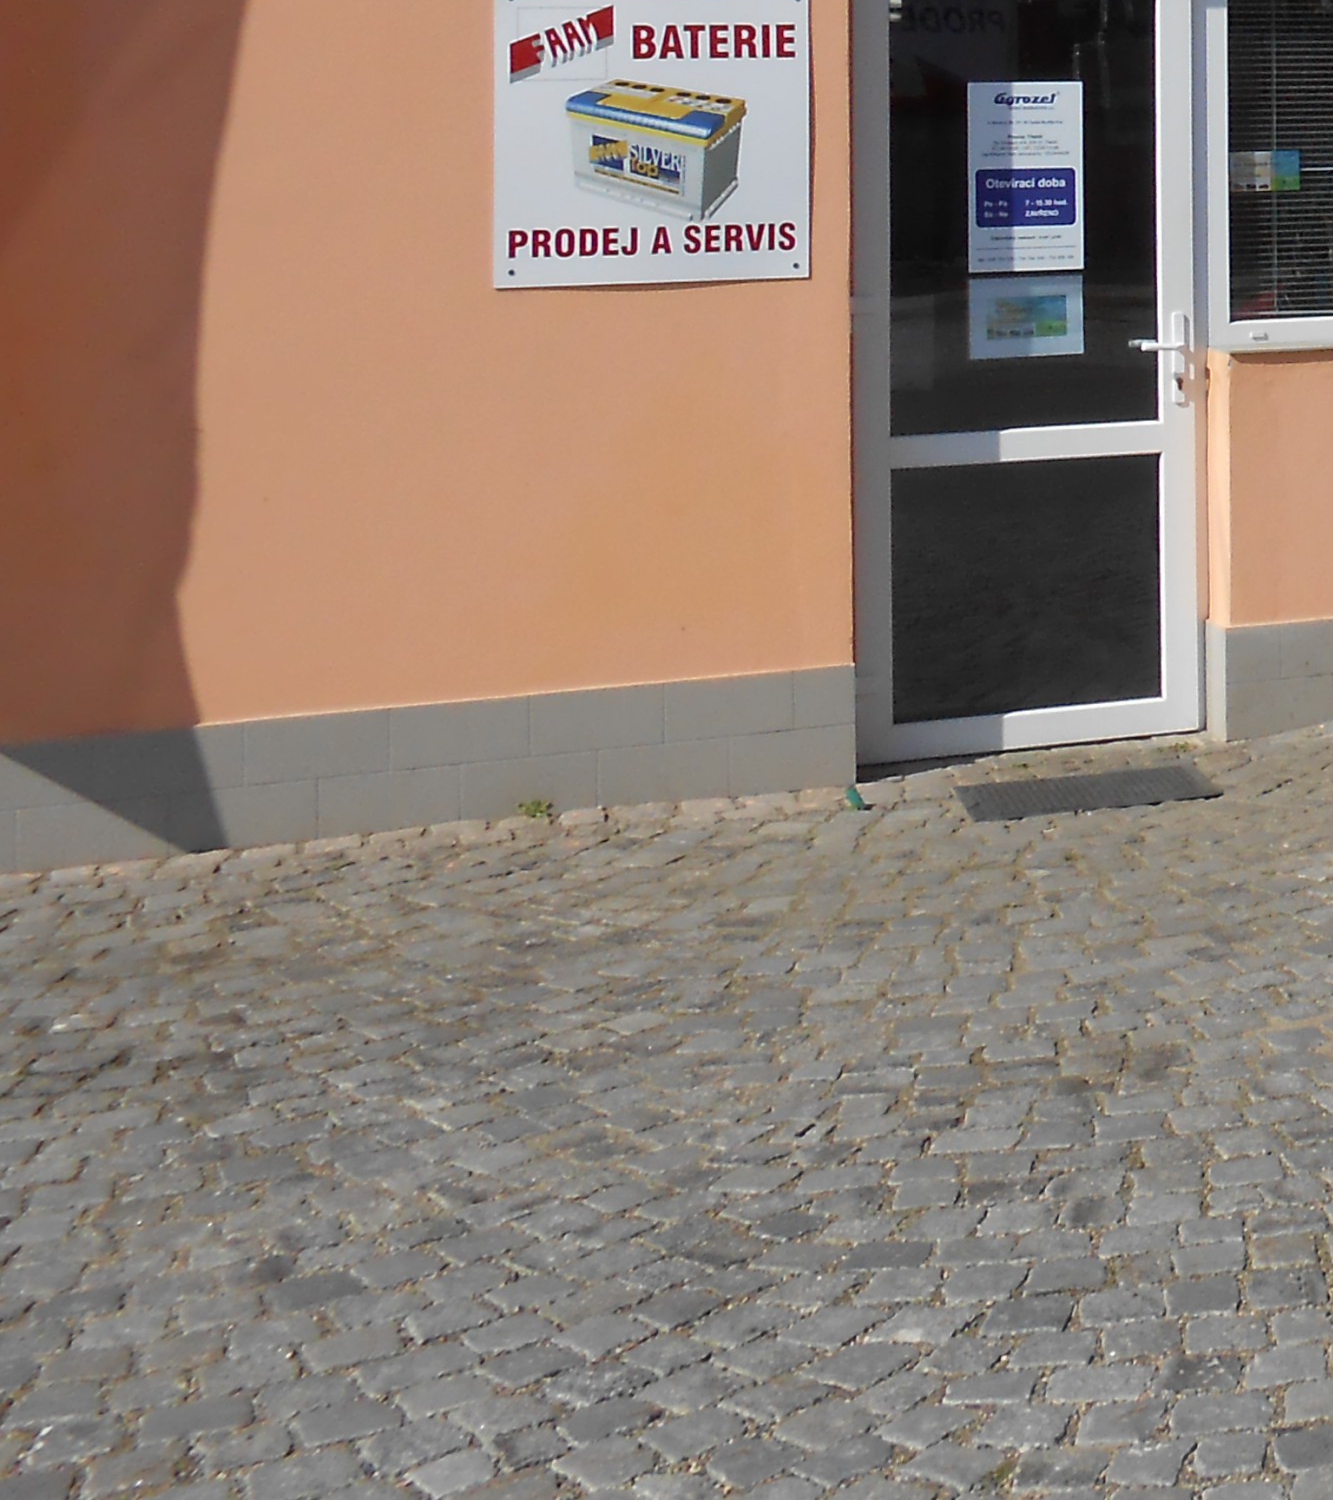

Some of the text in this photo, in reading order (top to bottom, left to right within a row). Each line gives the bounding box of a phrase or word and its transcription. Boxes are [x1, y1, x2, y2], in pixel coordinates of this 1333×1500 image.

[632, 24, 796, 60] BATERIE
[630, 143, 682, 172] SILVER
[1037, 177, 1067, 188] doba
[508, 222, 796, 259] PRODEJ A SERVIS
